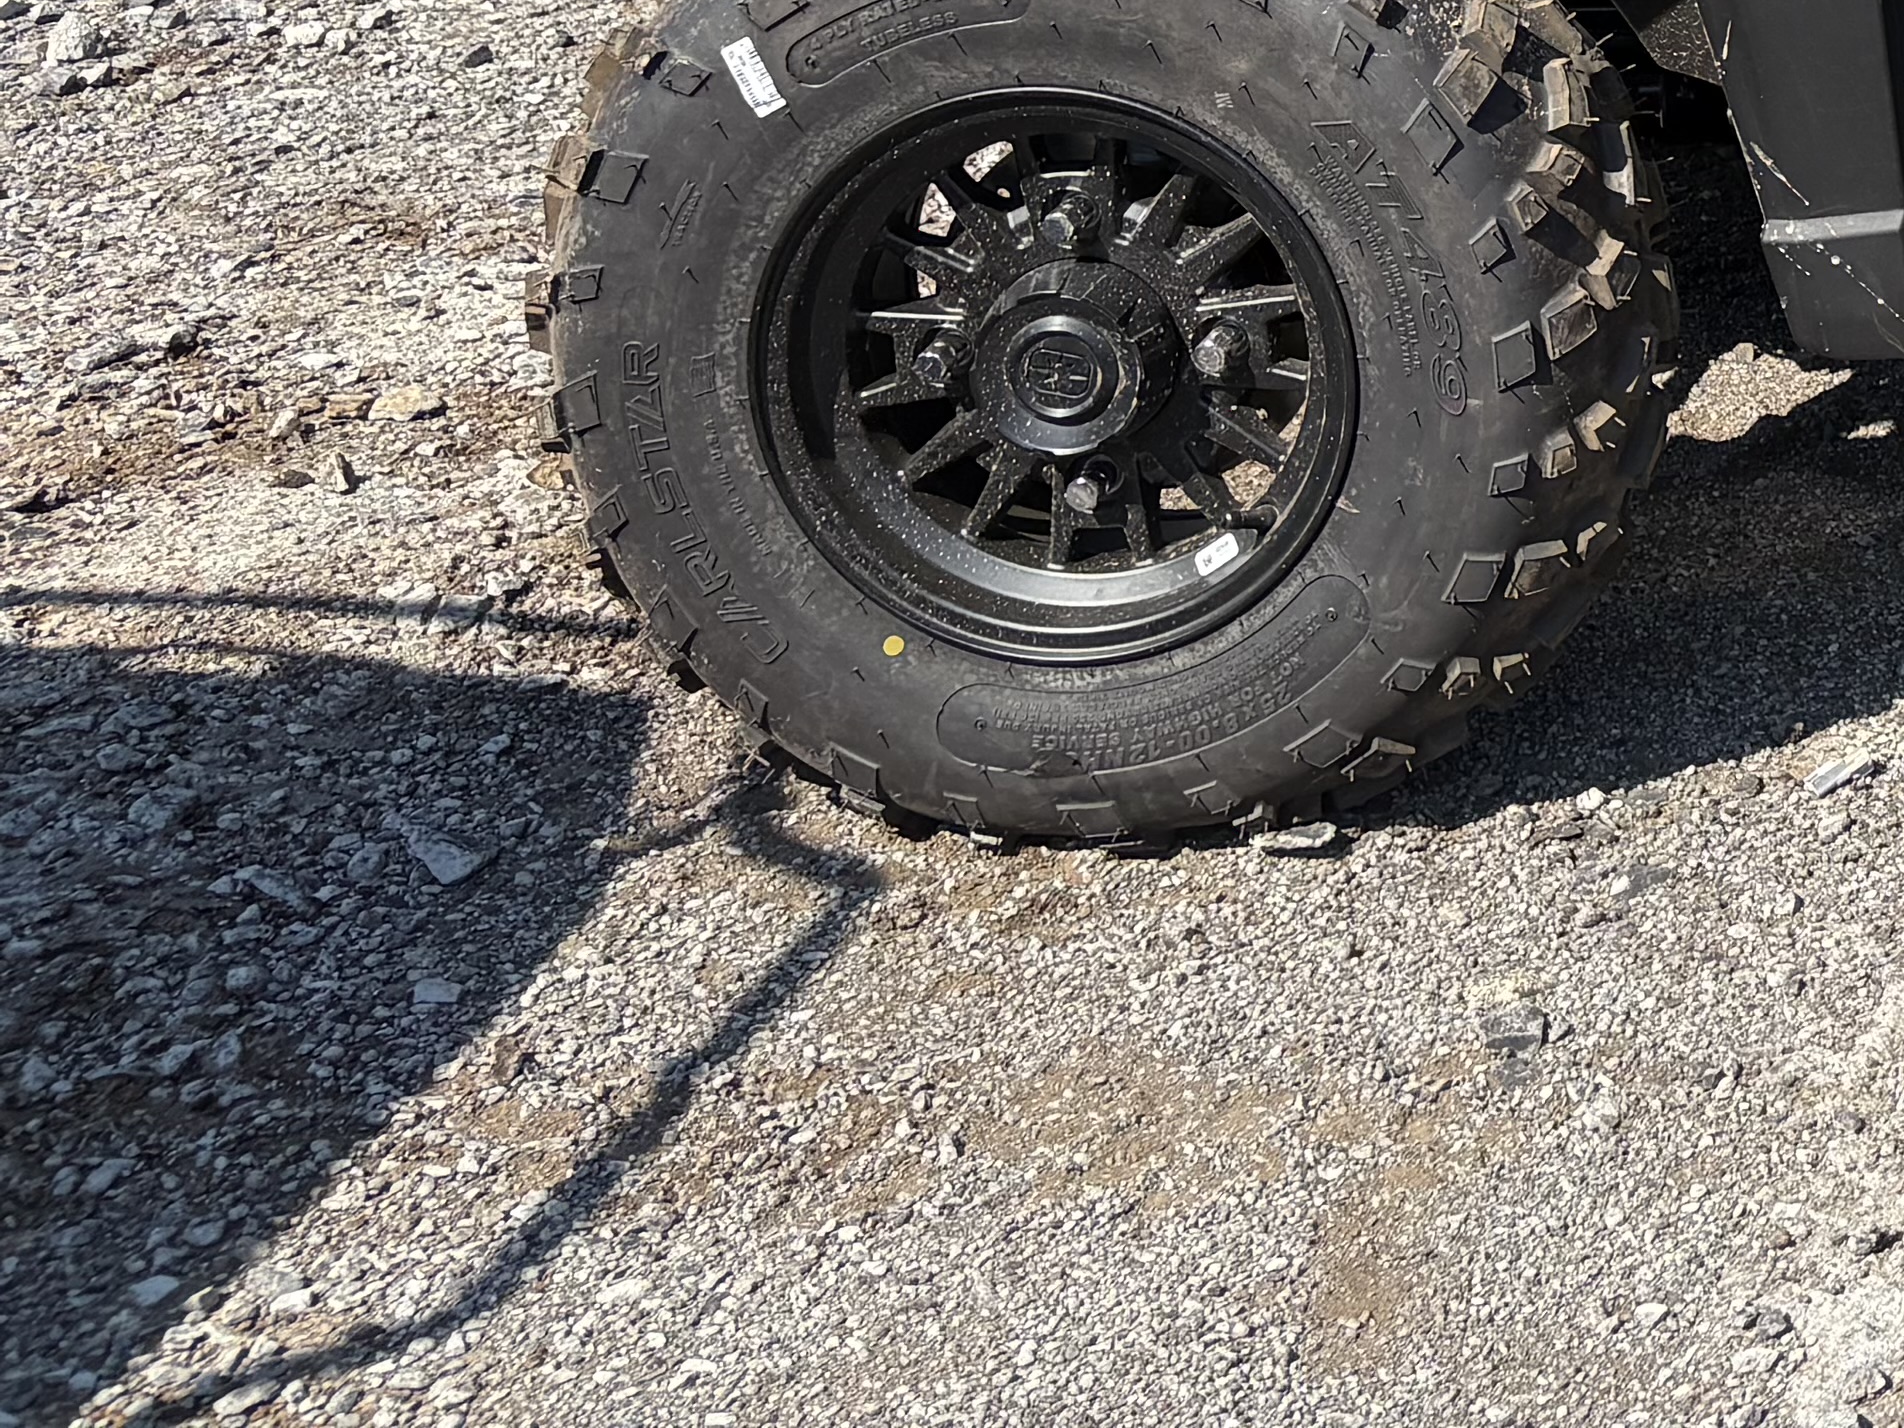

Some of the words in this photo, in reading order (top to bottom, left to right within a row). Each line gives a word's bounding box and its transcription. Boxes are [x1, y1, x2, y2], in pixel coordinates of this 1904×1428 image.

[621, 339, 793, 669] CARLSTAR
[1264, 650, 1305, 686] NOT
[1224, 677, 1266, 710] FOR
[1126, 699, 1223, 746] HIGHWAY
